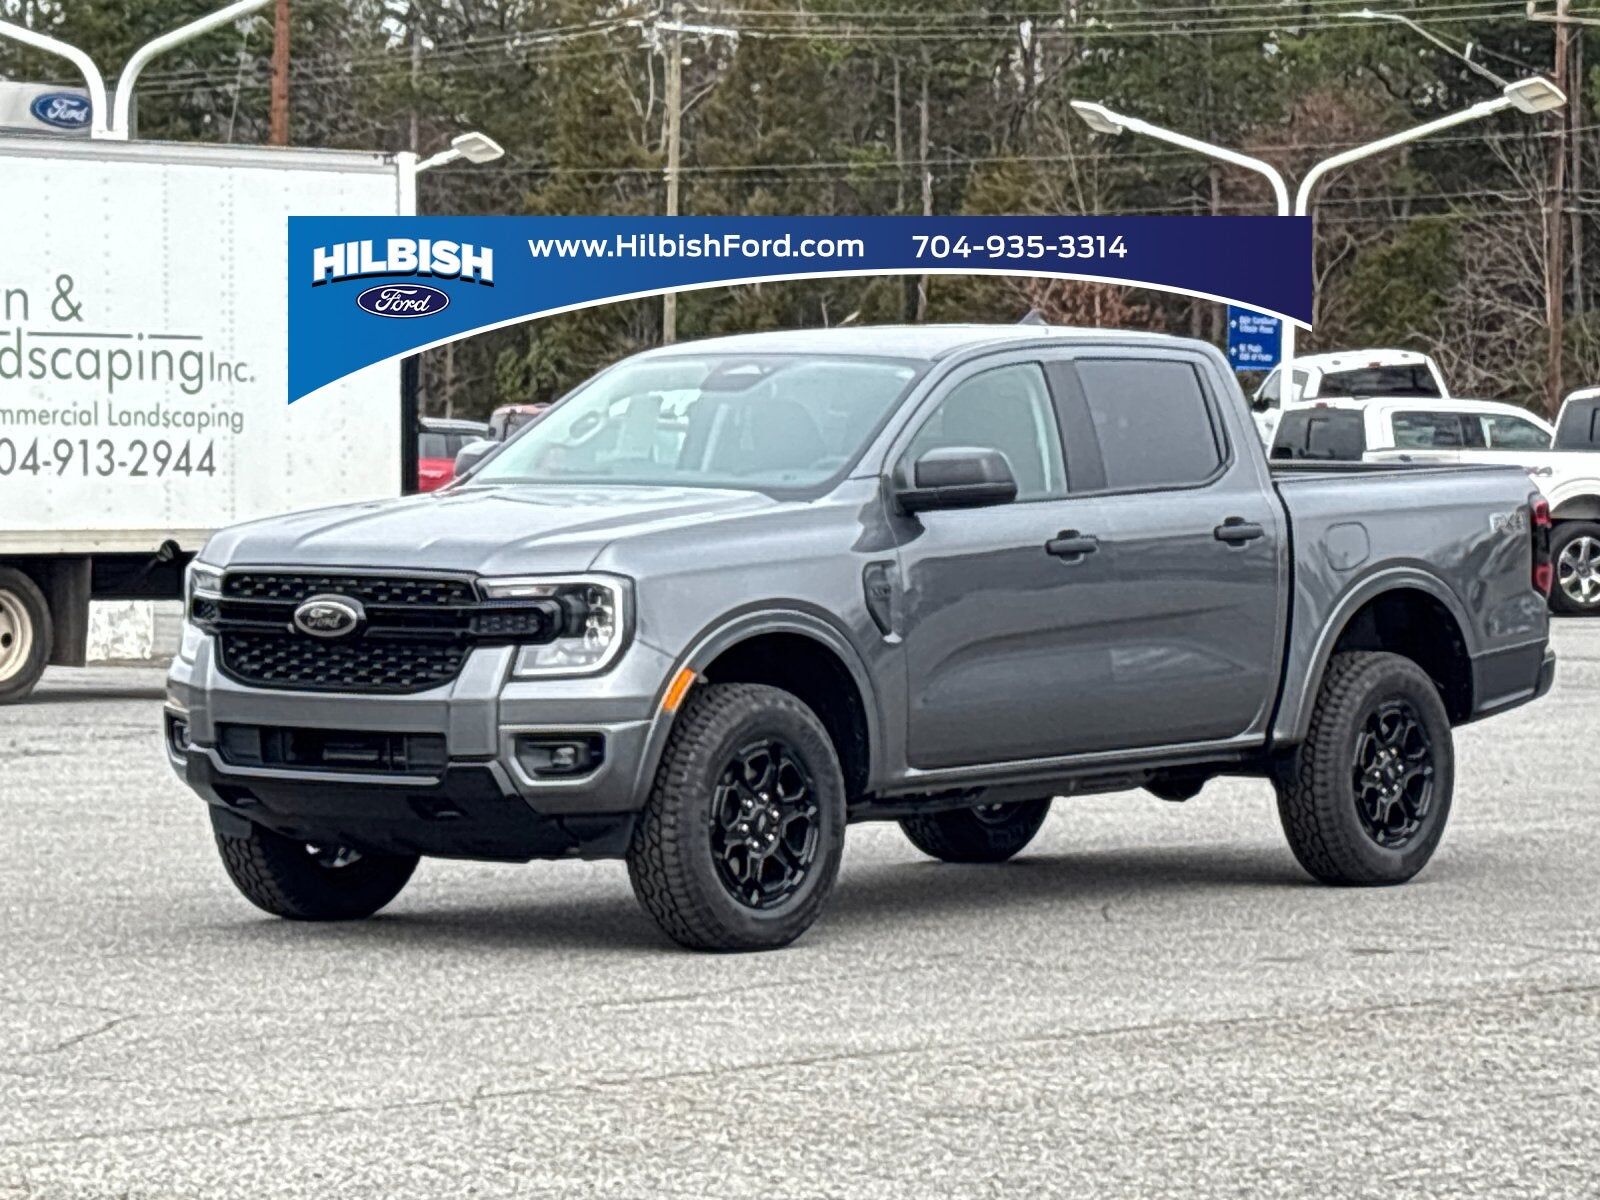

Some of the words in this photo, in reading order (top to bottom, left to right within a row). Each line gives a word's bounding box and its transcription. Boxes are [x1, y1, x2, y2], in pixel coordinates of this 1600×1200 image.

[46, 98, 90, 122] Ford
[51, 274, 84, 322] &
[0, 327, 203, 395] dscaping
[209, 351, 256, 383] Inc.
[108, 401, 244, 434] Landscaping
[0, 437, 216, 477] 04-913-2944
[306, 607, 343, 629] Ford
